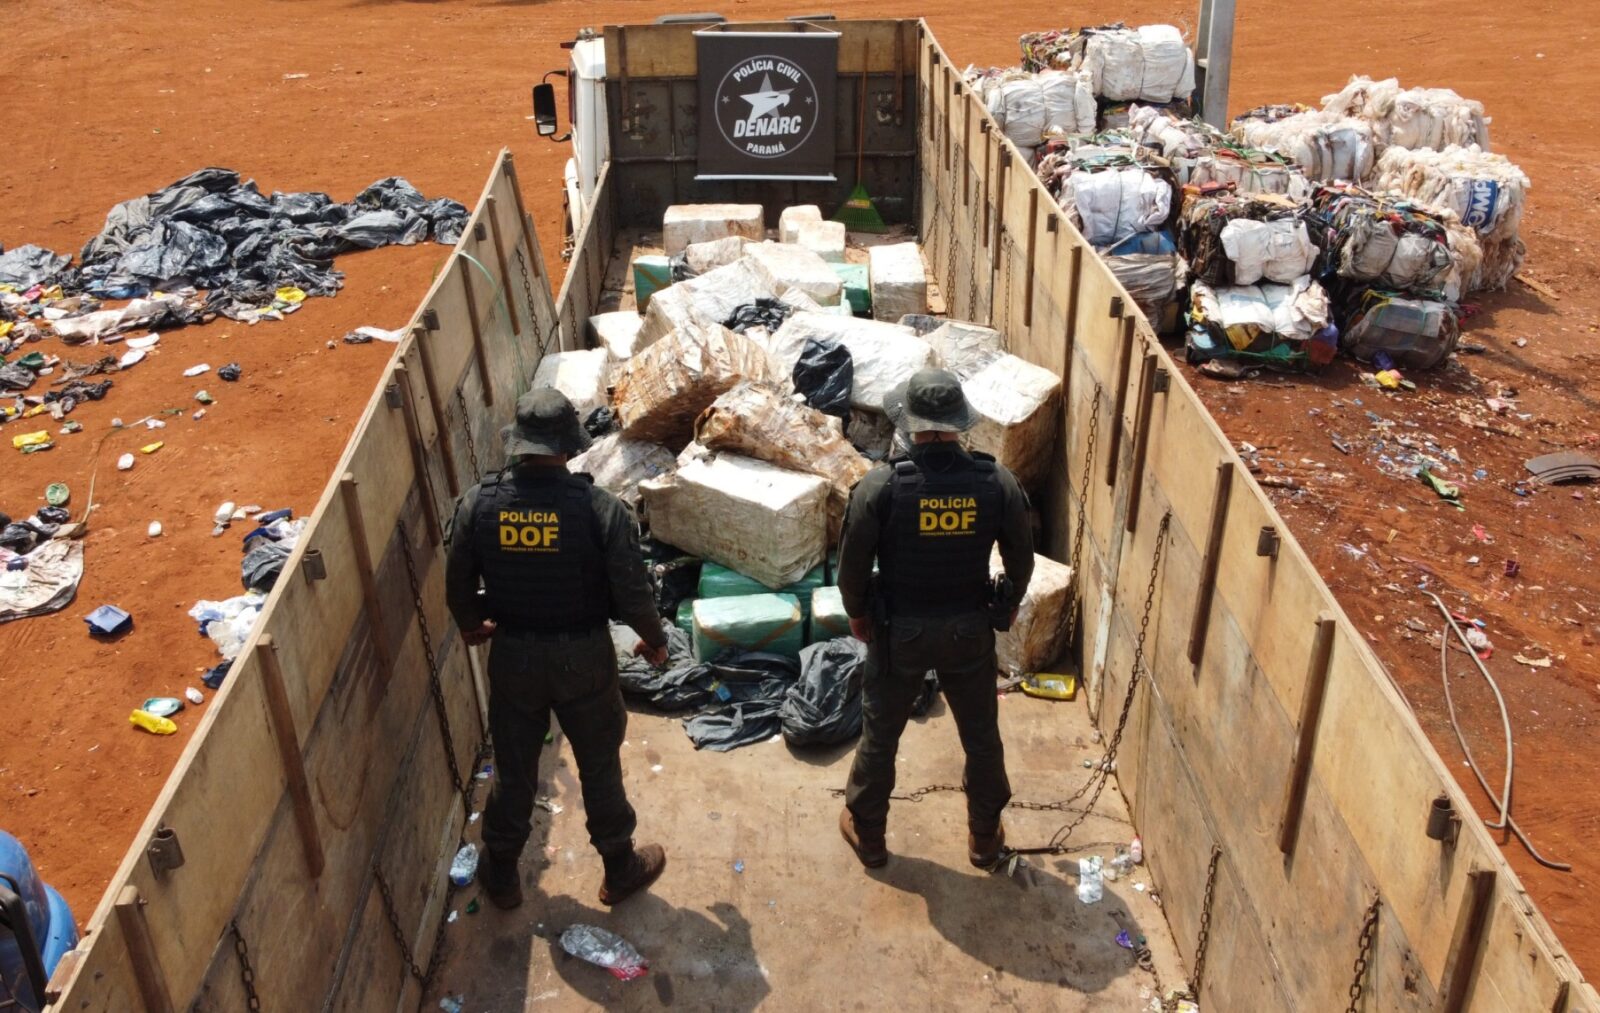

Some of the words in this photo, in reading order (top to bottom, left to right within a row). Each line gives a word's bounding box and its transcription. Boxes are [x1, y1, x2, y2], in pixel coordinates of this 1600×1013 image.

[733, 60, 774, 82] POLÍCIA
[776, 62, 802, 83] CIVIL
[733, 116, 802, 138] DENARC
[746, 141, 786, 154] PARANÁ
[919, 496, 977, 509] POLÍCIA
[499, 509, 559, 523] POLÍCIA
[919, 511, 977, 531] DOF
[499, 525, 559, 547] DOF
